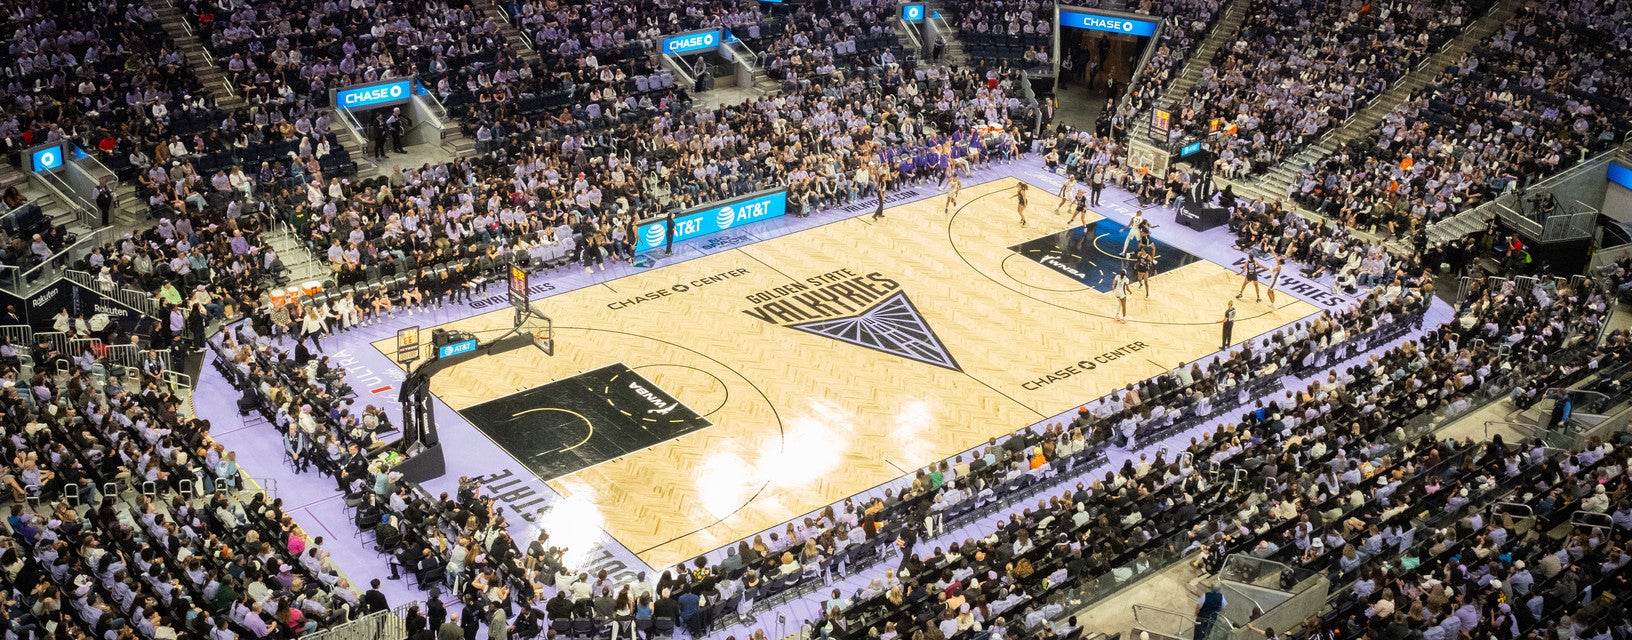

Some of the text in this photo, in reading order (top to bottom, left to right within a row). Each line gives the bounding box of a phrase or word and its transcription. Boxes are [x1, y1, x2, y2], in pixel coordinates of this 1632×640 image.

[1083, 17, 1121, 30] CHASE
[669, 36, 703, 50] CHASE
[345, 88, 388, 104] CHASE
[737, 200, 771, 221] AT&T
[1048, 259, 1086, 279] WNBA
[607, 267, 751, 310] CHASE CENTER
[745, 267, 857, 304] GOLDEN STATE
[32, 287, 59, 307] Rakuten
[741, 271, 900, 324] VALKYRIES
[94, 304, 129, 317] Rakuten
[454, 342, 471, 353] AT&T
[331, 349, 382, 387] ULTRA
[1021, 341, 1150, 391] CHASE CENTER
[628, 381, 667, 408] WNBA
